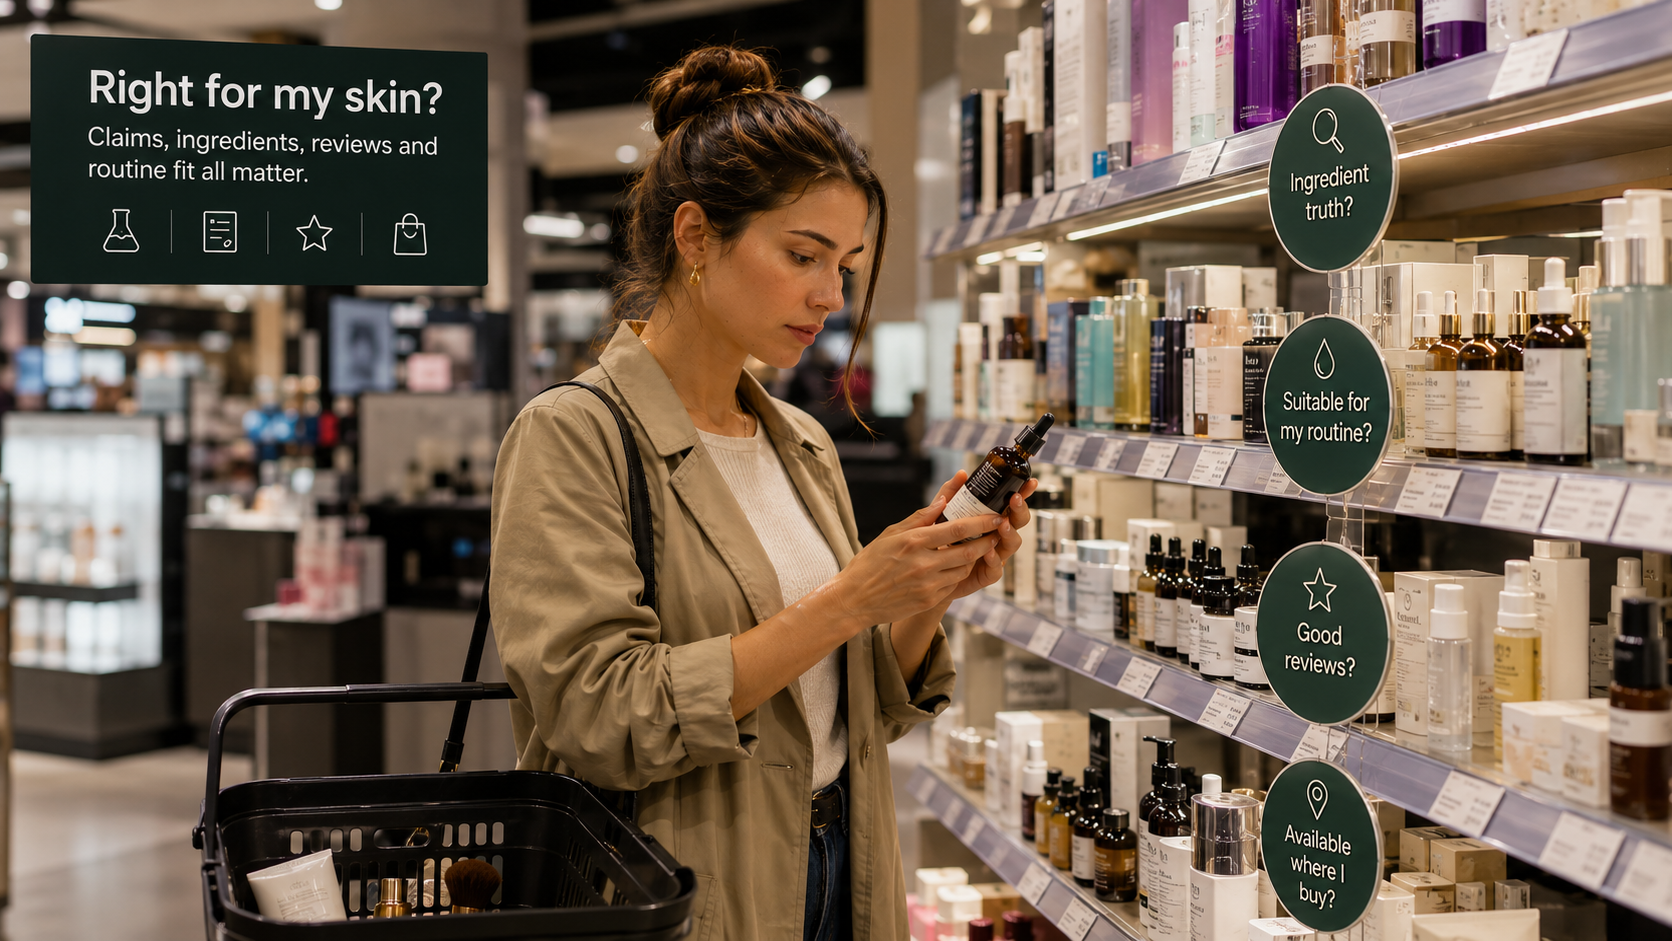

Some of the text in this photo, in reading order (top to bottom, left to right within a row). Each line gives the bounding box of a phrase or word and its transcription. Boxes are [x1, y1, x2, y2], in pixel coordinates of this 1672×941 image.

[91, 69, 442, 119] Right for my skin?
[88, 127, 437, 155] Claims, ingredients, reviews and
[89, 159, 308, 182] routine fit all matter.
[1290, 164, 1369, 195] Ingredient
[1305, 196, 1353, 220] truth?
[1284, 391, 1370, 411] Suitable for
[1281, 422, 1372, 444] my routine?
[1298, 622, 1341, 645] Good
[1286, 653, 1355, 677] reviews?
[1284, 824, 1351, 855] Available
[1290, 854, 1345, 884] where I
[1300, 881, 1335, 910] buy?
